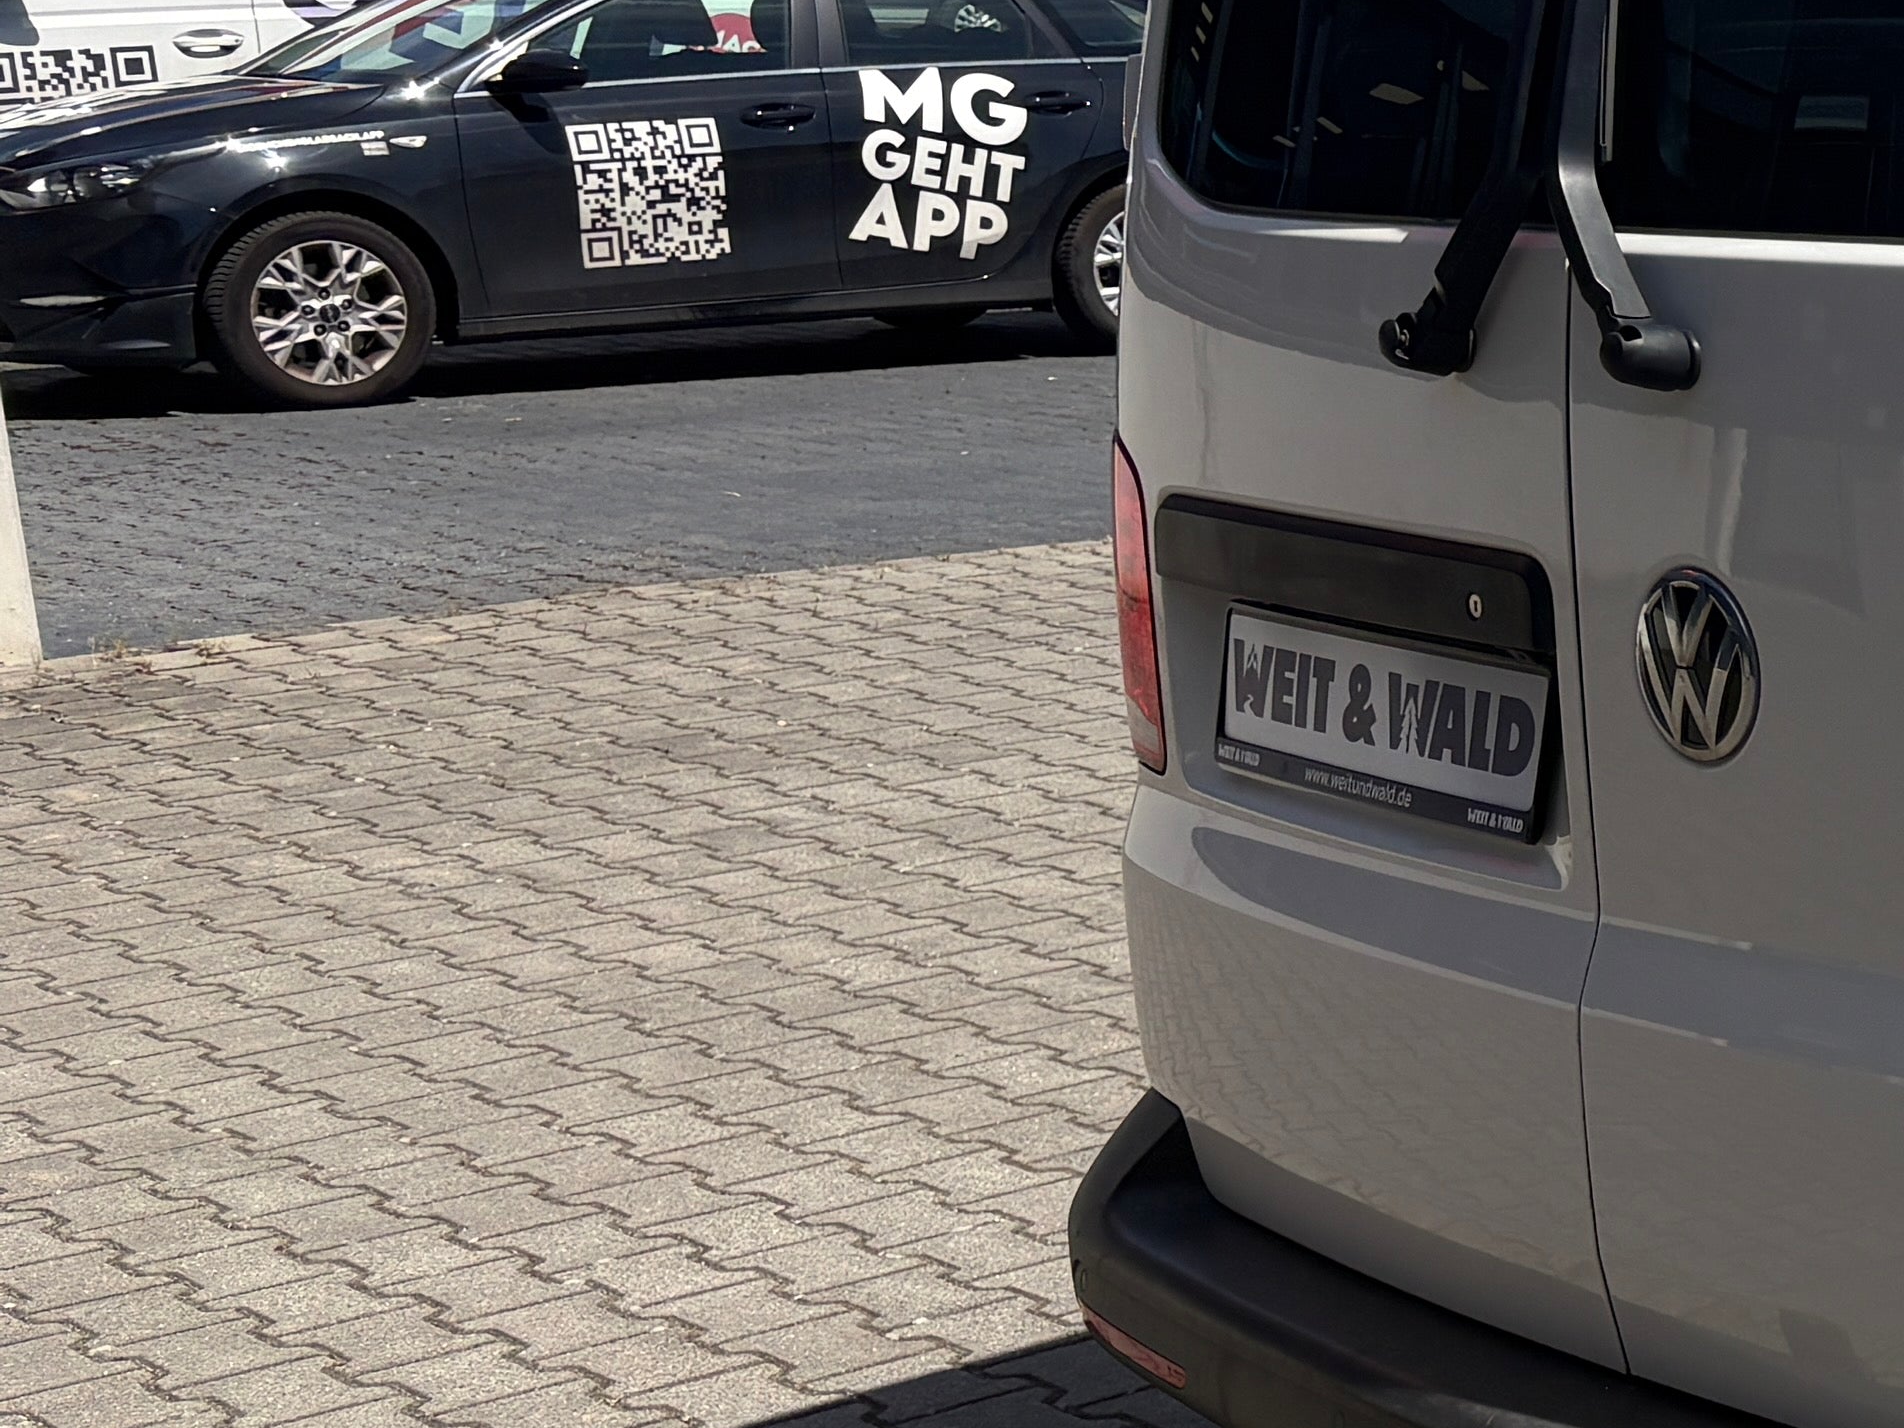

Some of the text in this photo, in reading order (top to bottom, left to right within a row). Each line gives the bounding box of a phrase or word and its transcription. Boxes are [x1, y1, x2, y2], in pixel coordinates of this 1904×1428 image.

[858, 67, 1028, 145] MG
[861, 128, 1026, 202] GEHT
[849, 183, 1009, 260] APP
[1233, 637, 1536, 777] WEIT & WALD
[1304, 767, 1413, 808] www.weitundwald.de
